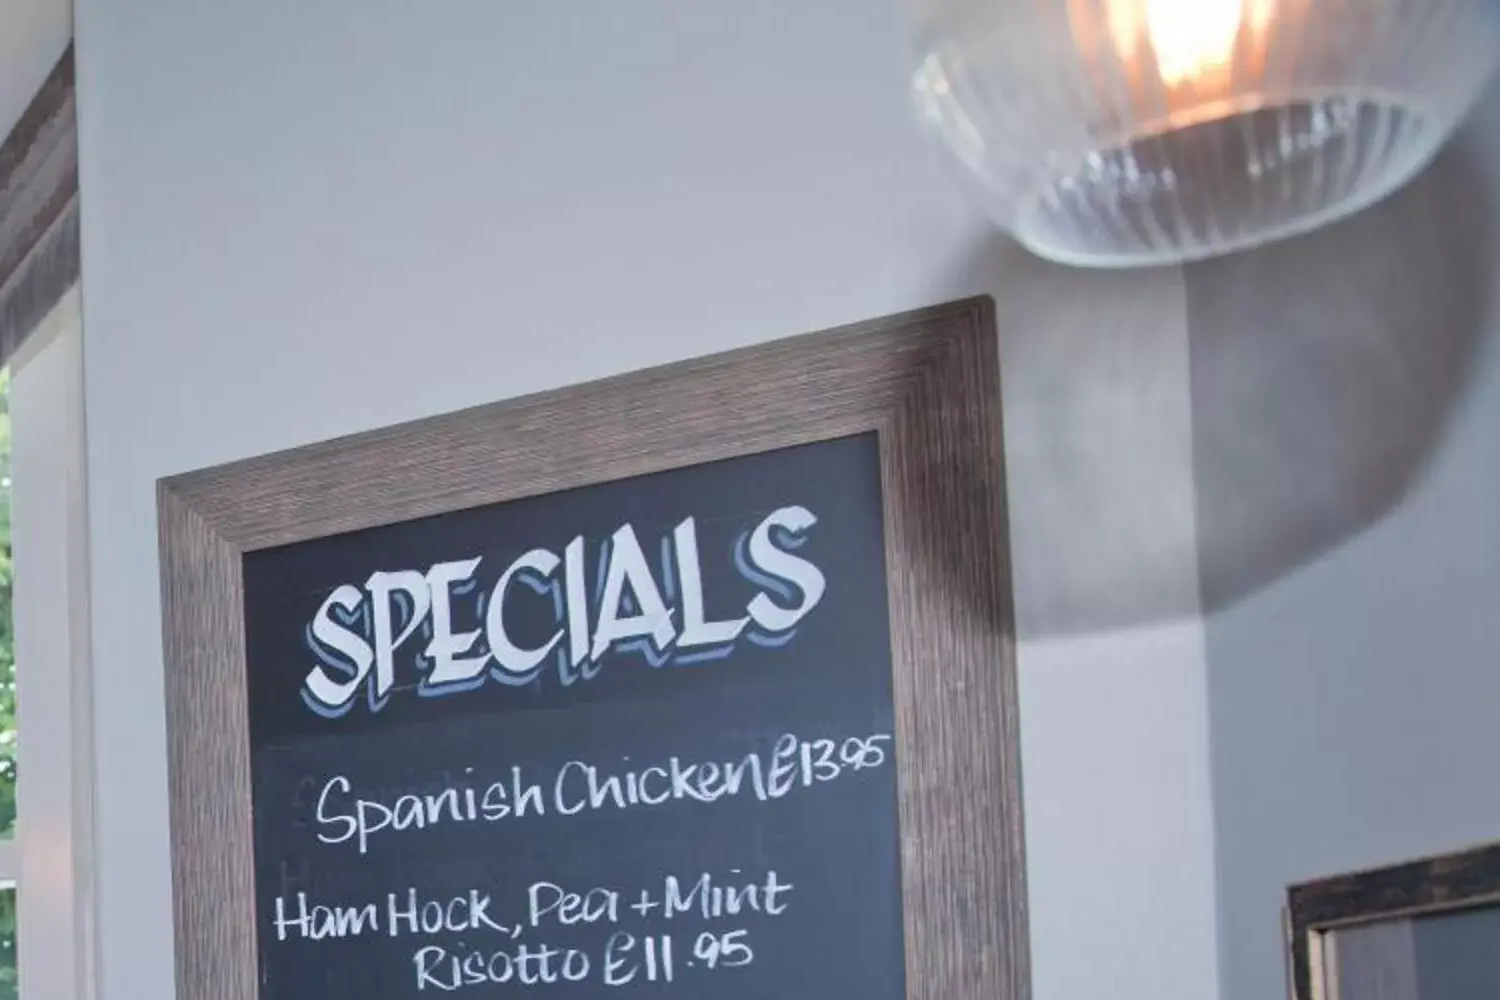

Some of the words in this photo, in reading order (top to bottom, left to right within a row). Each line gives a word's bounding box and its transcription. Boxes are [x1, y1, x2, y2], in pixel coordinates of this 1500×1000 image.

[302, 505, 826, 712] SPECIALS
[316, 766, 546, 854] Spanish
[555, 752, 767, 815] Chicken
[274, 891, 379, 940] Ham
[529, 881, 619, 927] Pea
[663, 869, 794, 918] Mint
[413, 942, 590, 991] Risotto
[604, 929, 755, 986] £11.95
